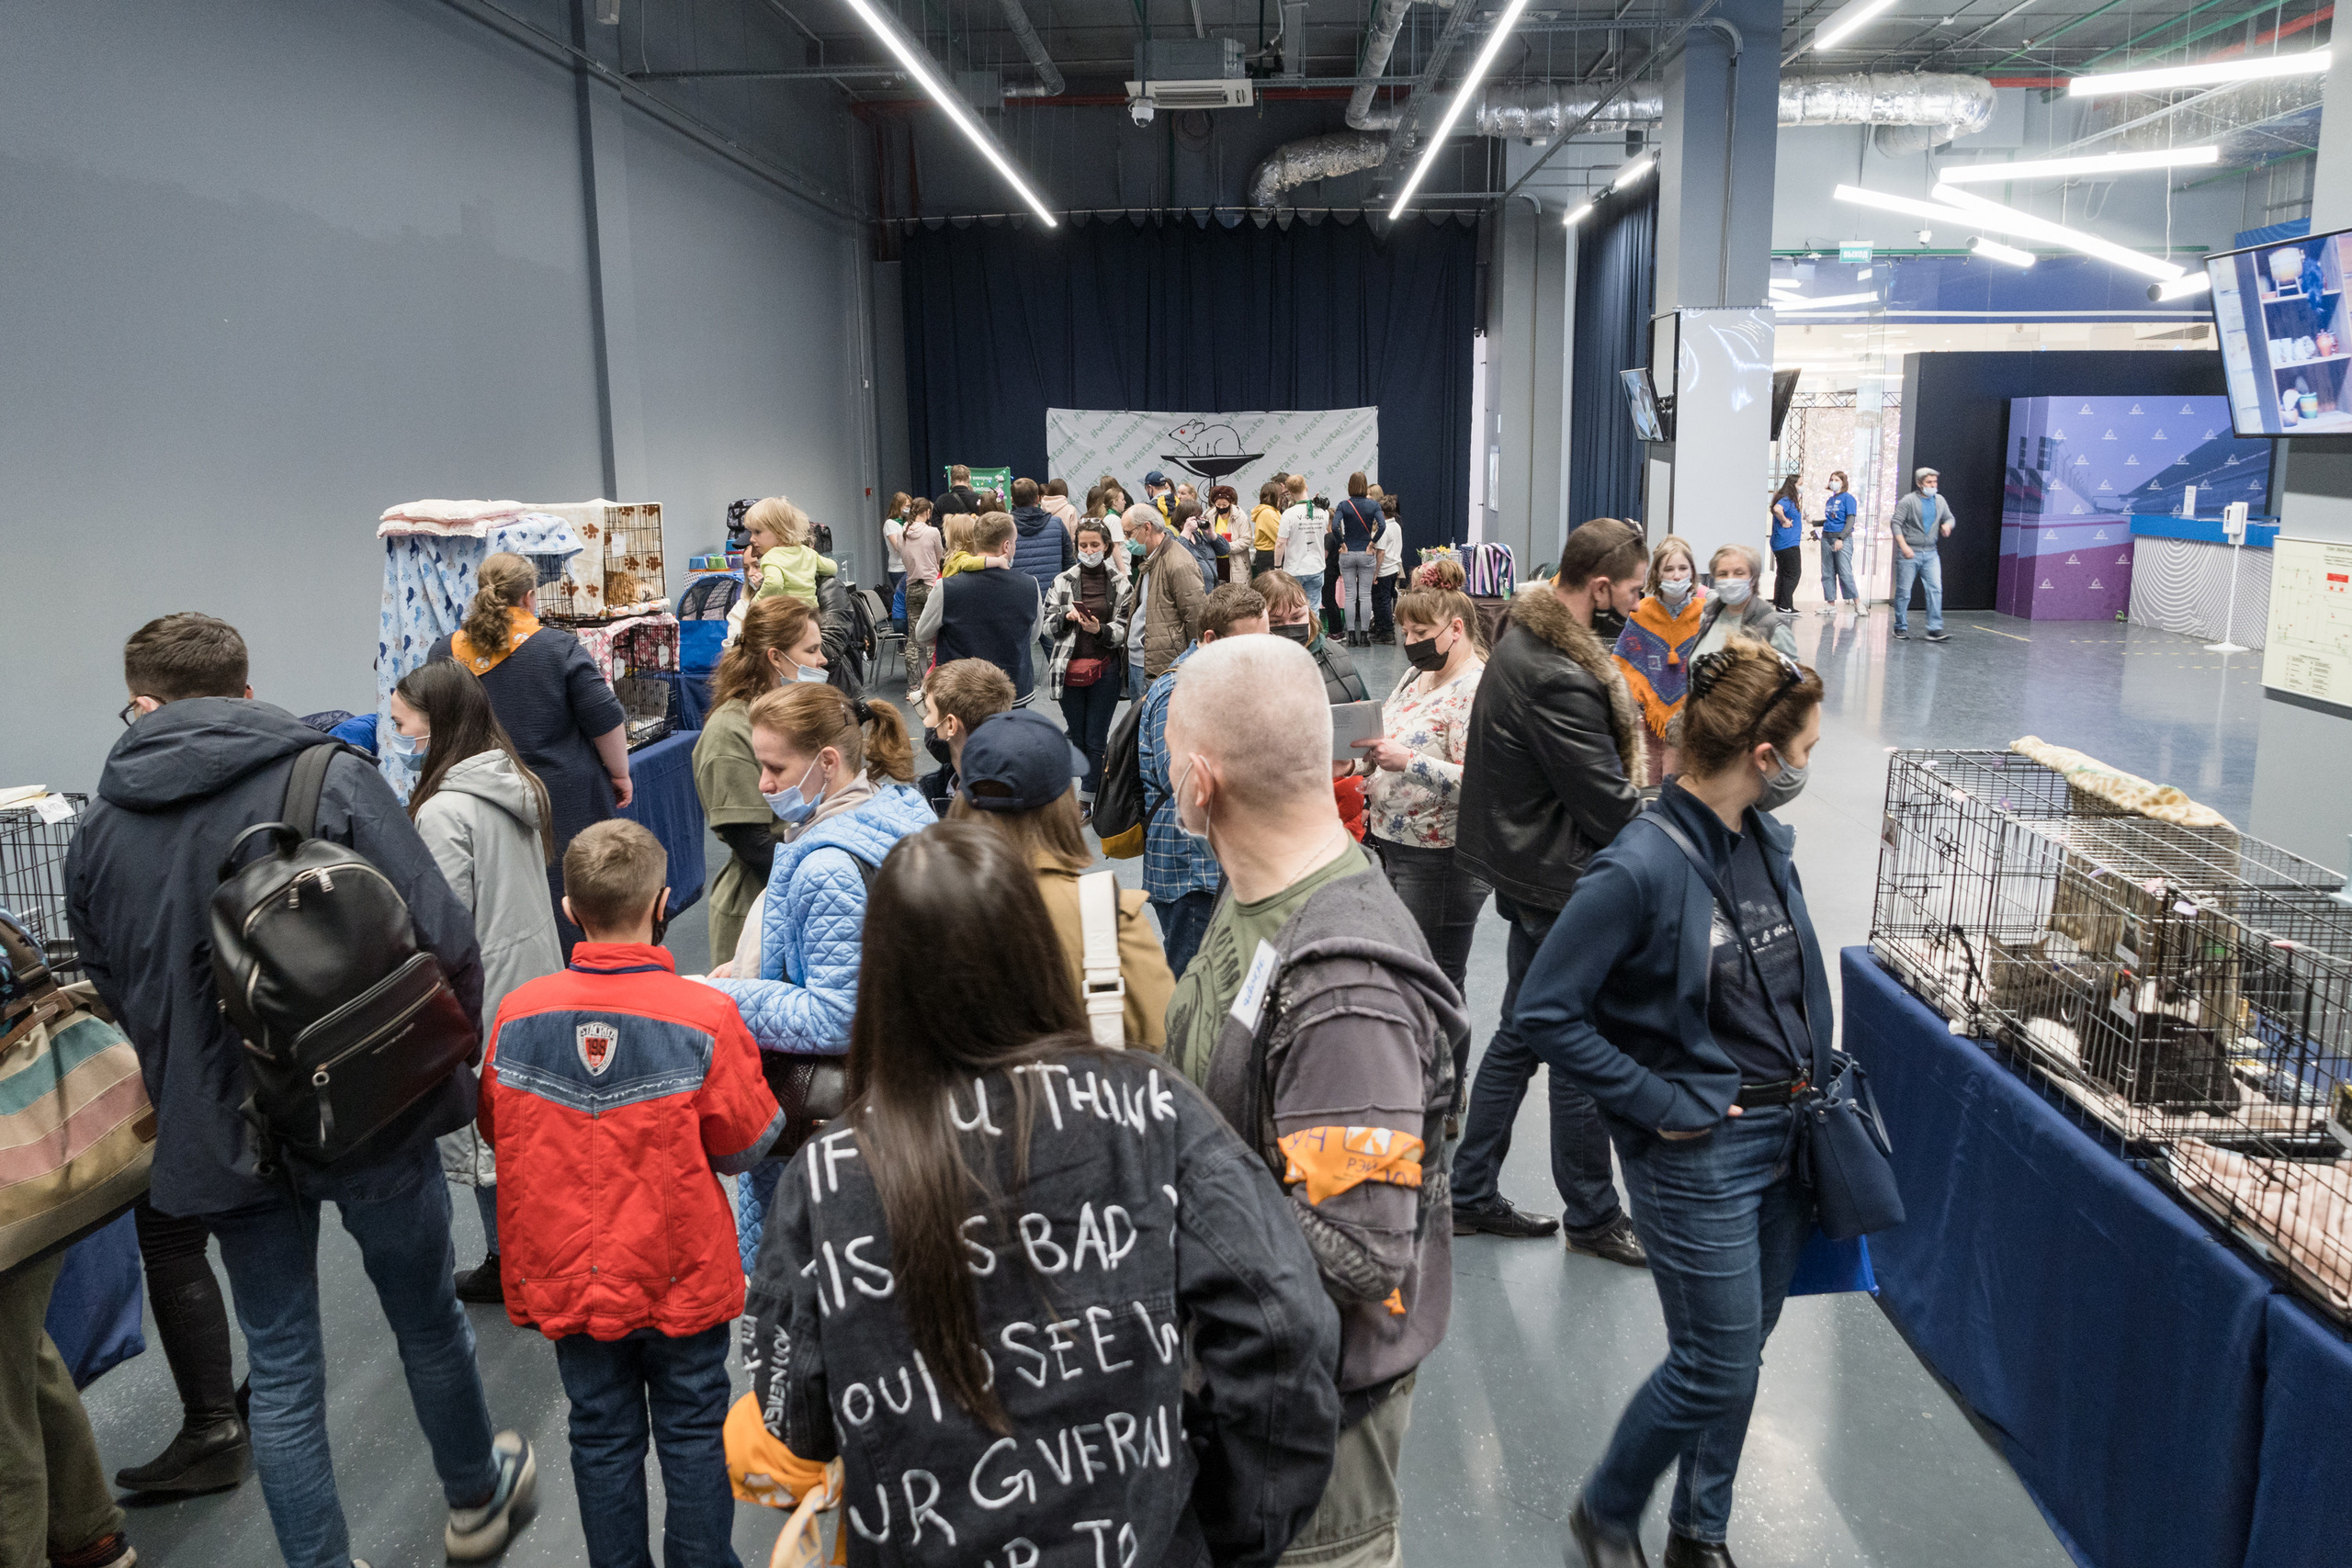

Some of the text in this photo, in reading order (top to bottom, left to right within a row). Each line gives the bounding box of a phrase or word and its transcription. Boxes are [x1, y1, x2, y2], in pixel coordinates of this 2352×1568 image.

[1843, 250, 1869, 259] ВЫХОД
[1123, 425, 1170, 470] #wistarats
[1310, 410, 1358, 458] #wistarats
[1326, 423, 1373, 475] #wistarats
[808, 1126, 858, 1204] IF
[1019, 1201, 1137, 1275] BAD
[1001, 1306, 1134, 1388] SEE
